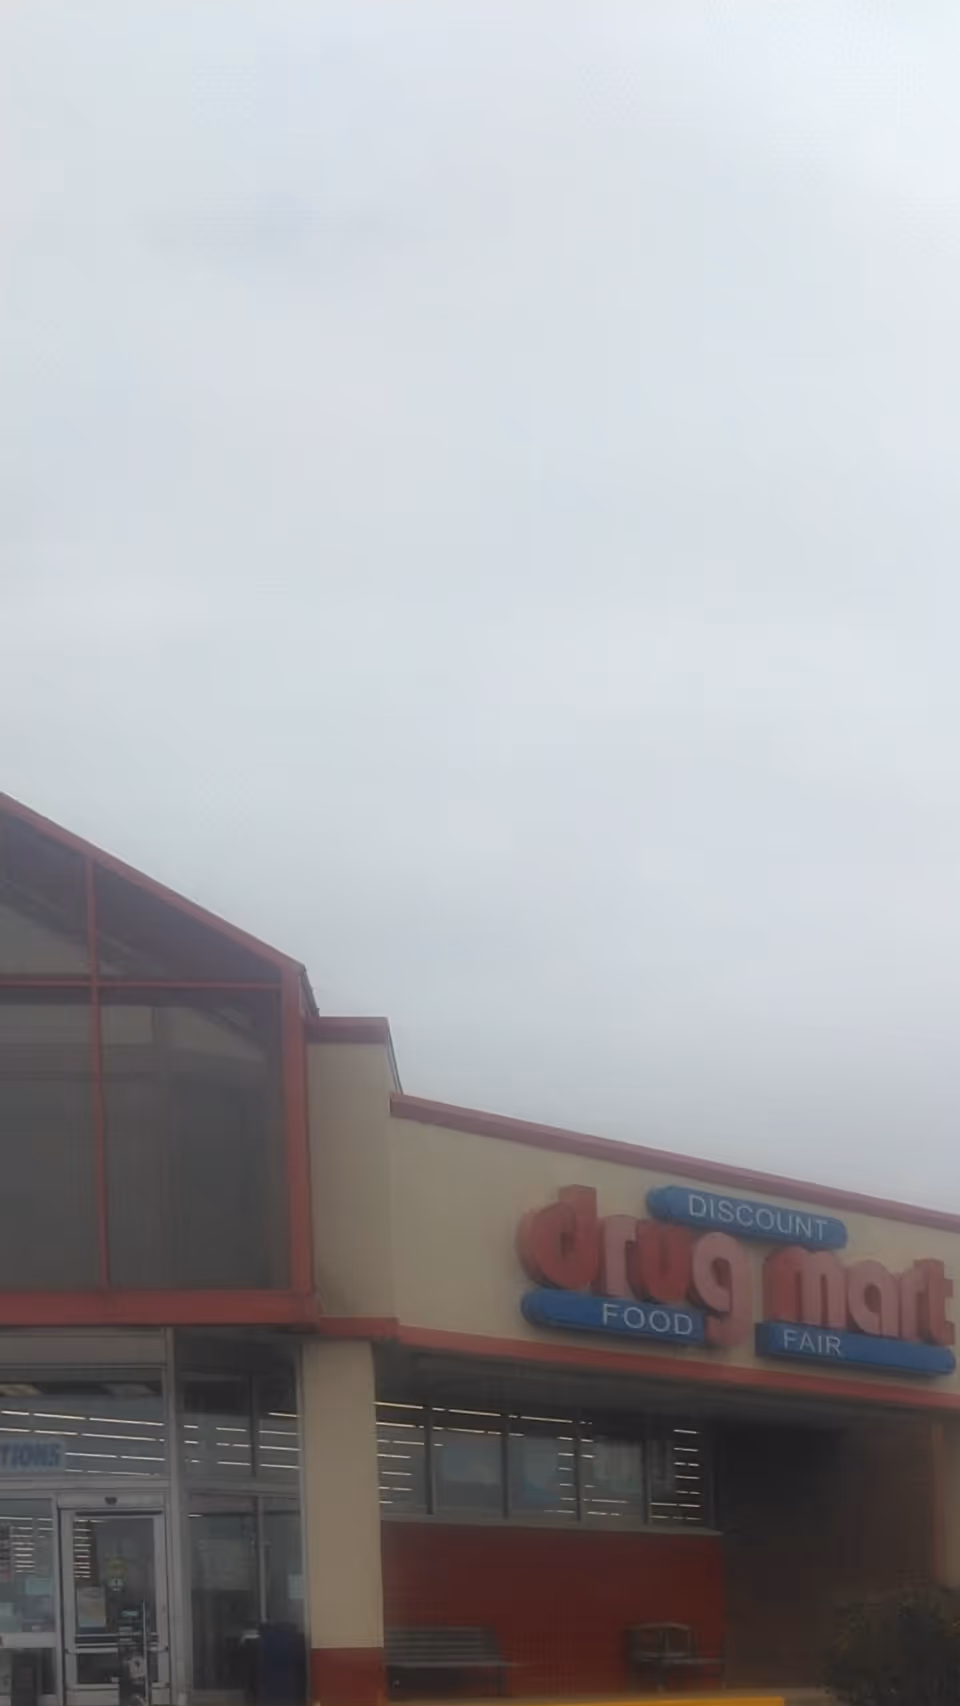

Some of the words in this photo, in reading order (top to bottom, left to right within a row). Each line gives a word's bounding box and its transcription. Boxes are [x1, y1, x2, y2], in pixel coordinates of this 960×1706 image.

[688, 1194, 828, 1241] DISCOUNT
[517, 1184, 753, 1346] drug
[763, 1246, 955, 1346] mart
[602, 1303, 693, 1336] FOOD
[783, 1330, 842, 1355] FAIR
